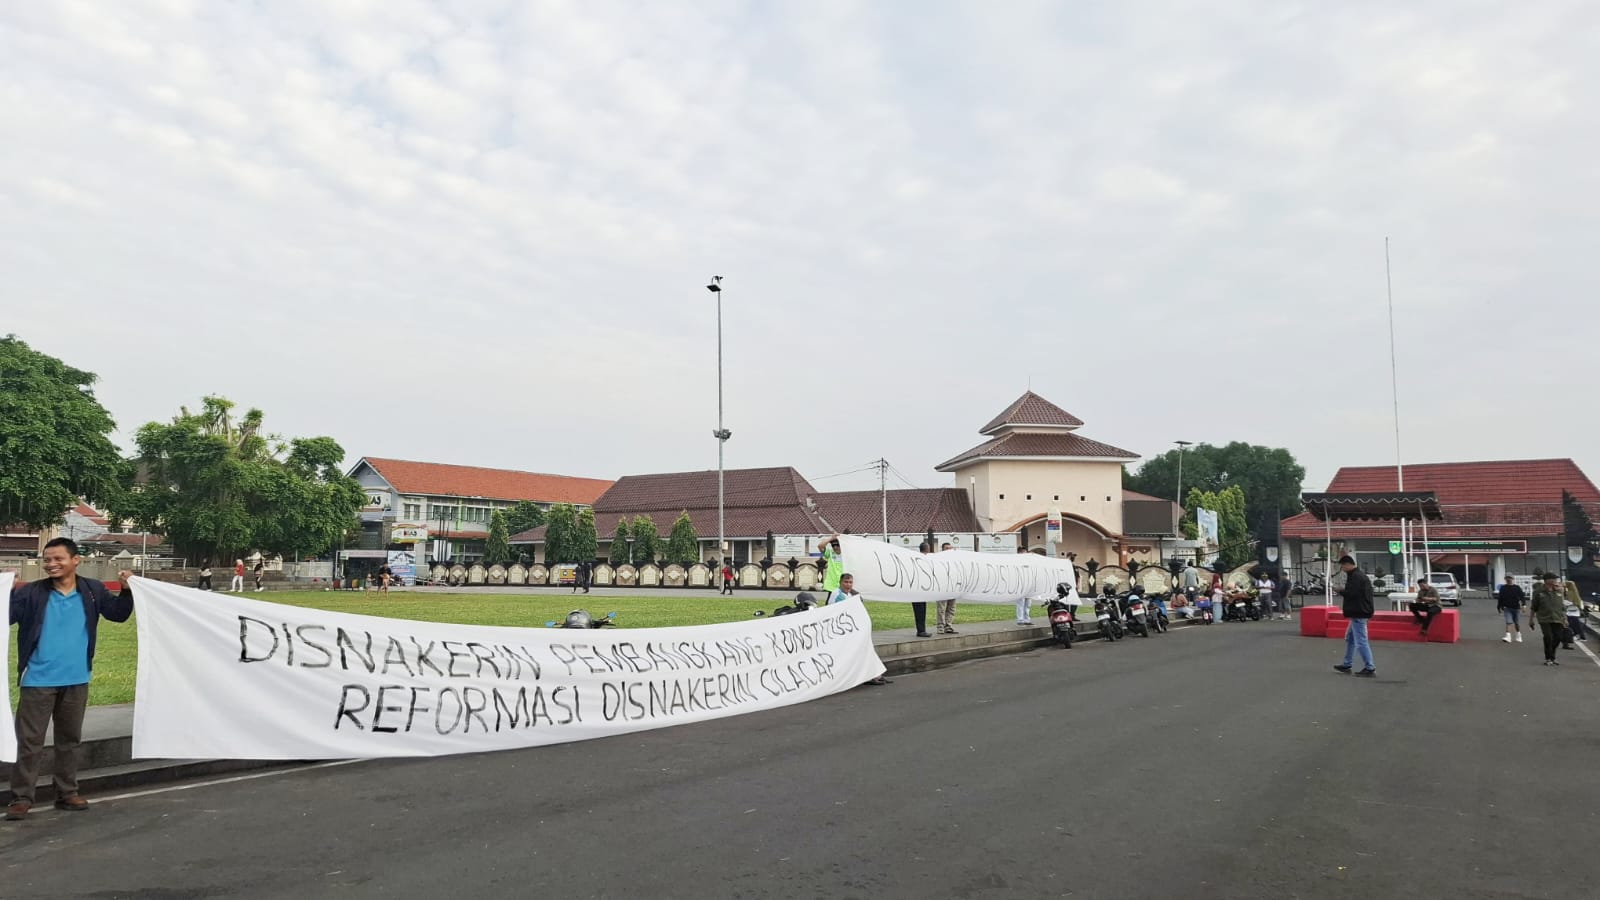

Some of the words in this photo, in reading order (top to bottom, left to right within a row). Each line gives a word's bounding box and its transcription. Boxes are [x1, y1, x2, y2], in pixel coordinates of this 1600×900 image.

[874, 551, 941, 592] UMSK
[238, 615, 541, 680] DISNAKERIN
[549, 636, 763, 676] PEMBANGKANG
[764, 611, 860, 656] KONSTITUSI
[334, 684, 583, 735] REFORMASI
[602, 672, 760, 722] DISNAKERIN
[760, 653, 835, 697] CILACAP
